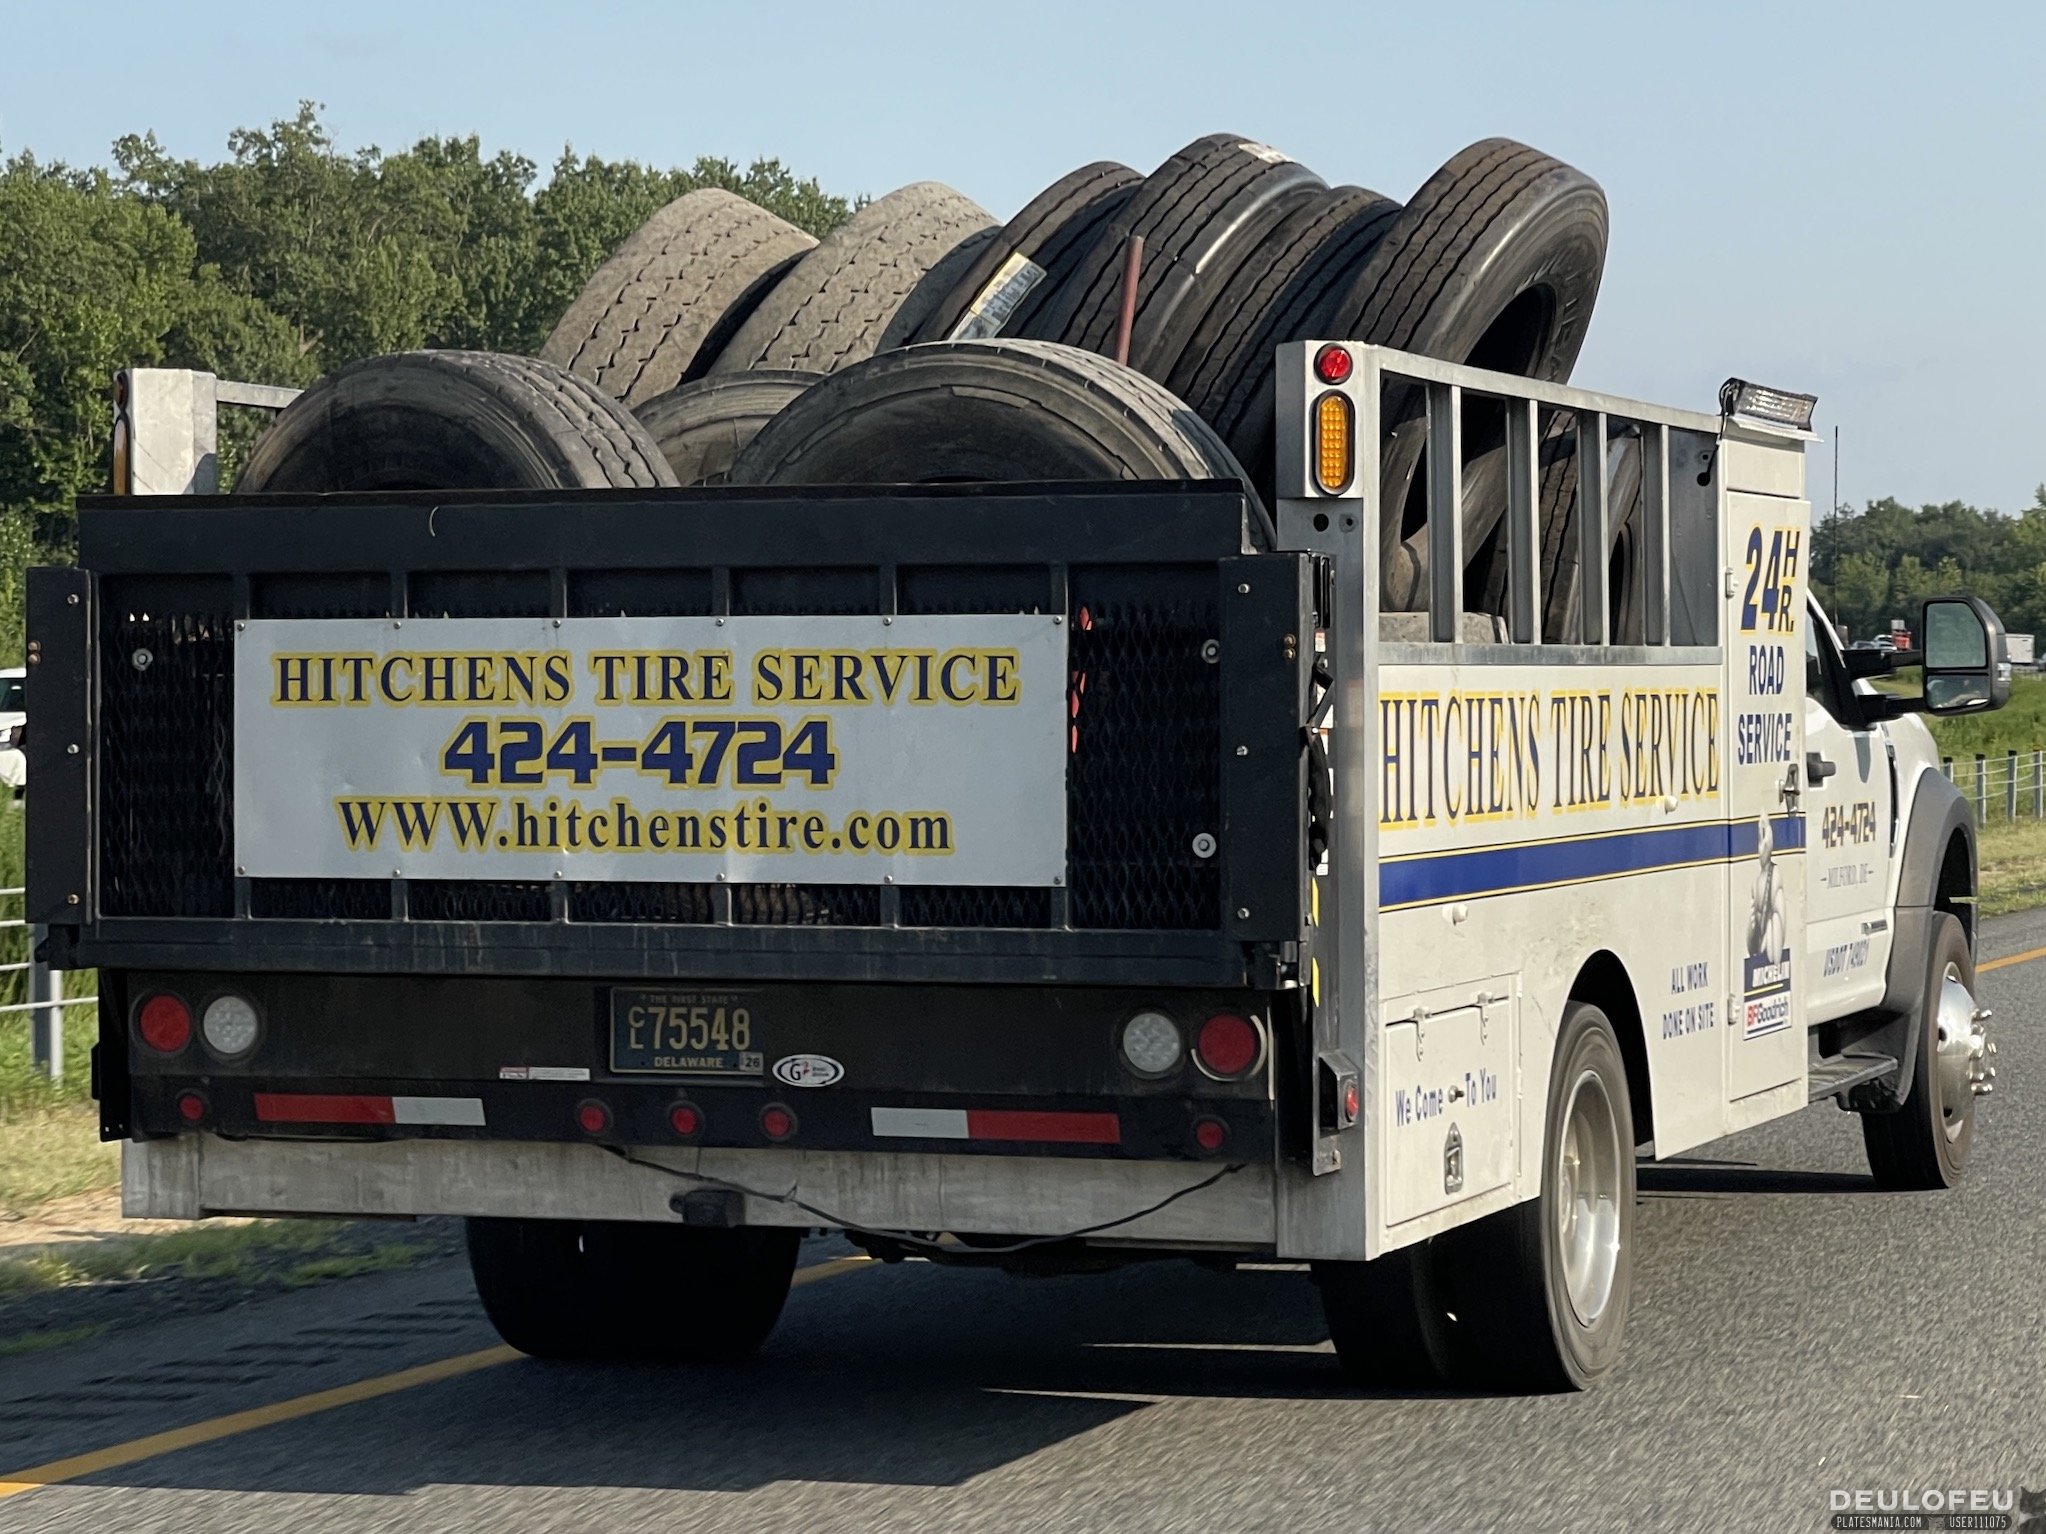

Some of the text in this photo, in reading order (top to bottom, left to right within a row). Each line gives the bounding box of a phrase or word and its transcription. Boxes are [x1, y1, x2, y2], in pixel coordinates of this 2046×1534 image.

[1740, 526, 1783, 631] 24
[273, 650, 1021, 705] HITCHENS TIRE SERVICE
[1749, 645, 1784, 695] ROAD
[443, 719, 837, 786] 424-4724
[1379, 690, 1719, 826] HITCHENS TIRE SERVICE
[1738, 713, 1792, 765] SERVICE
[340, 799, 953, 852] WWW.hitchenstire.com
[1822, 801, 1876, 848] 424-4724
[648, 1006, 750, 1050] 75548
[1698, 1003, 1714, 1030] SITE
[654, 1056, 760, 1068] DELAWARE 26
[1395, 1067, 1496, 1127] We Come To You
